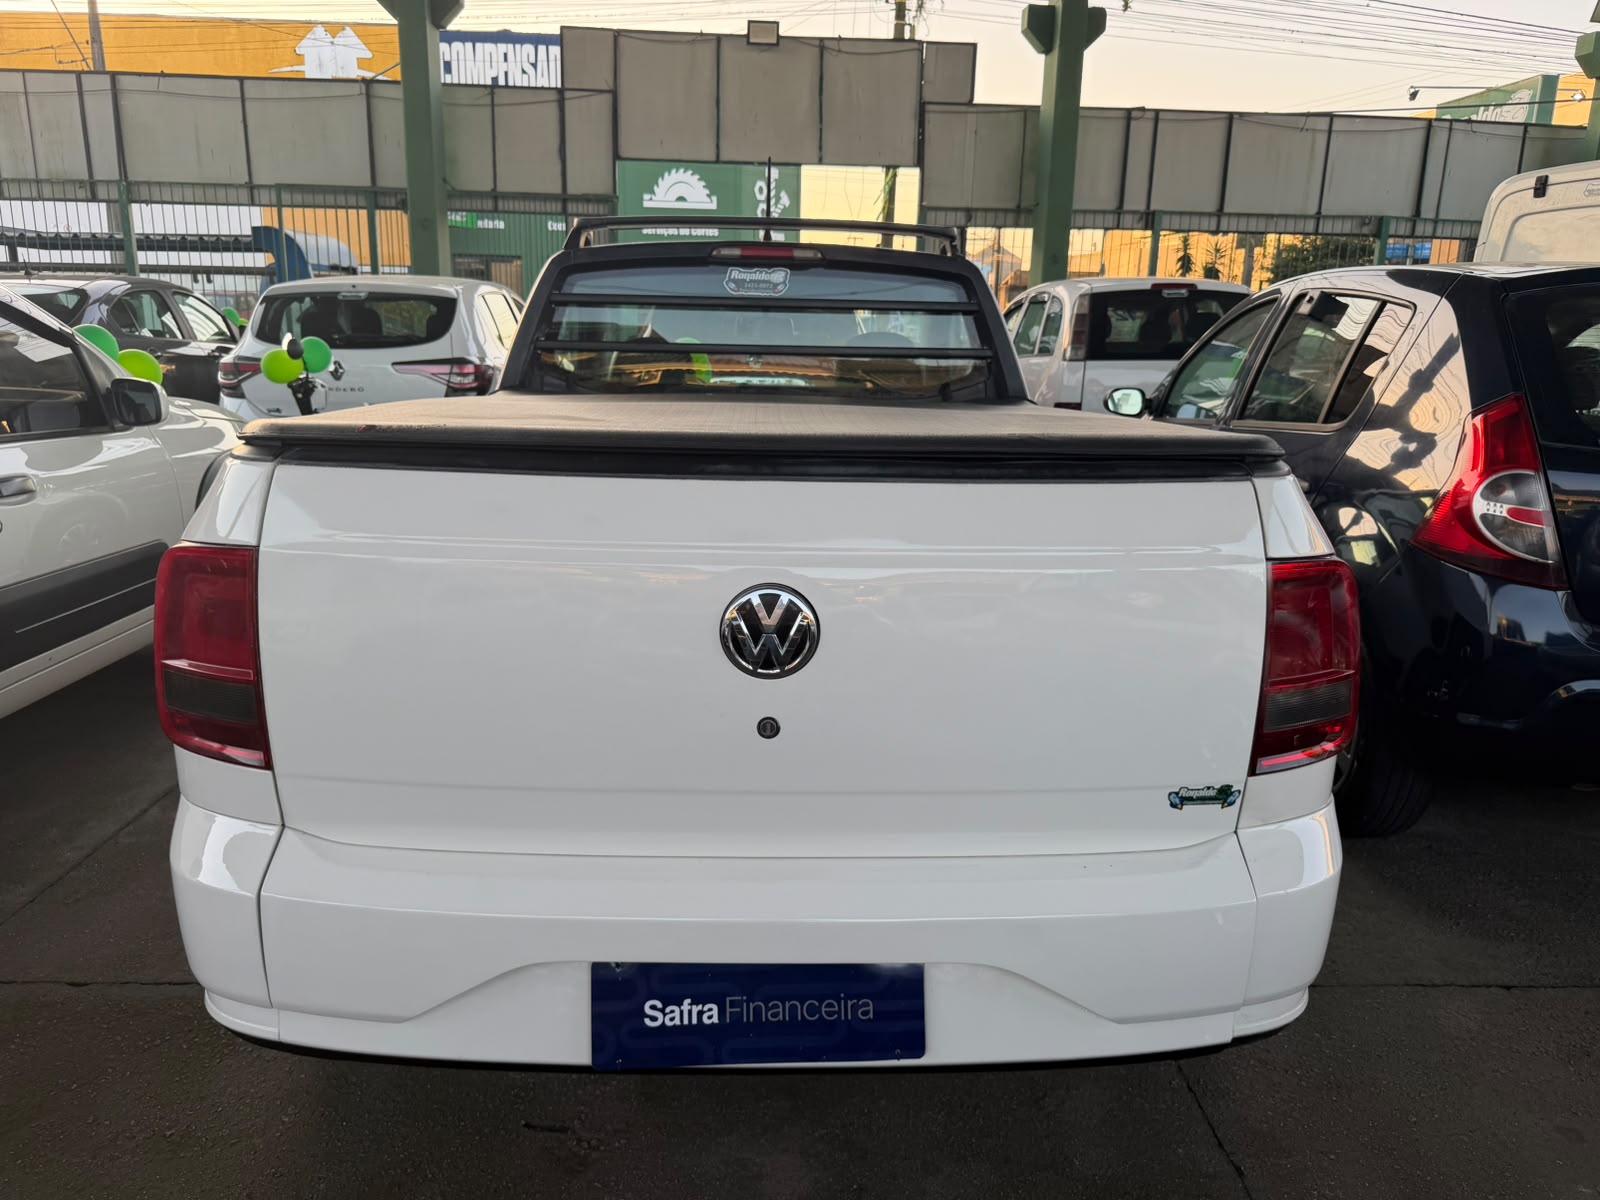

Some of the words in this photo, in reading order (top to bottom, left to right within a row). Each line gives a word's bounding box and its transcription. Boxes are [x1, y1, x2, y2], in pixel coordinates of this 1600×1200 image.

[731, 270, 770, 281] Ronaldo
[1178, 788, 1217, 798] Ronaldo
[643, 998, 719, 1028] Safra
[725, 993, 874, 1023] Financeira
